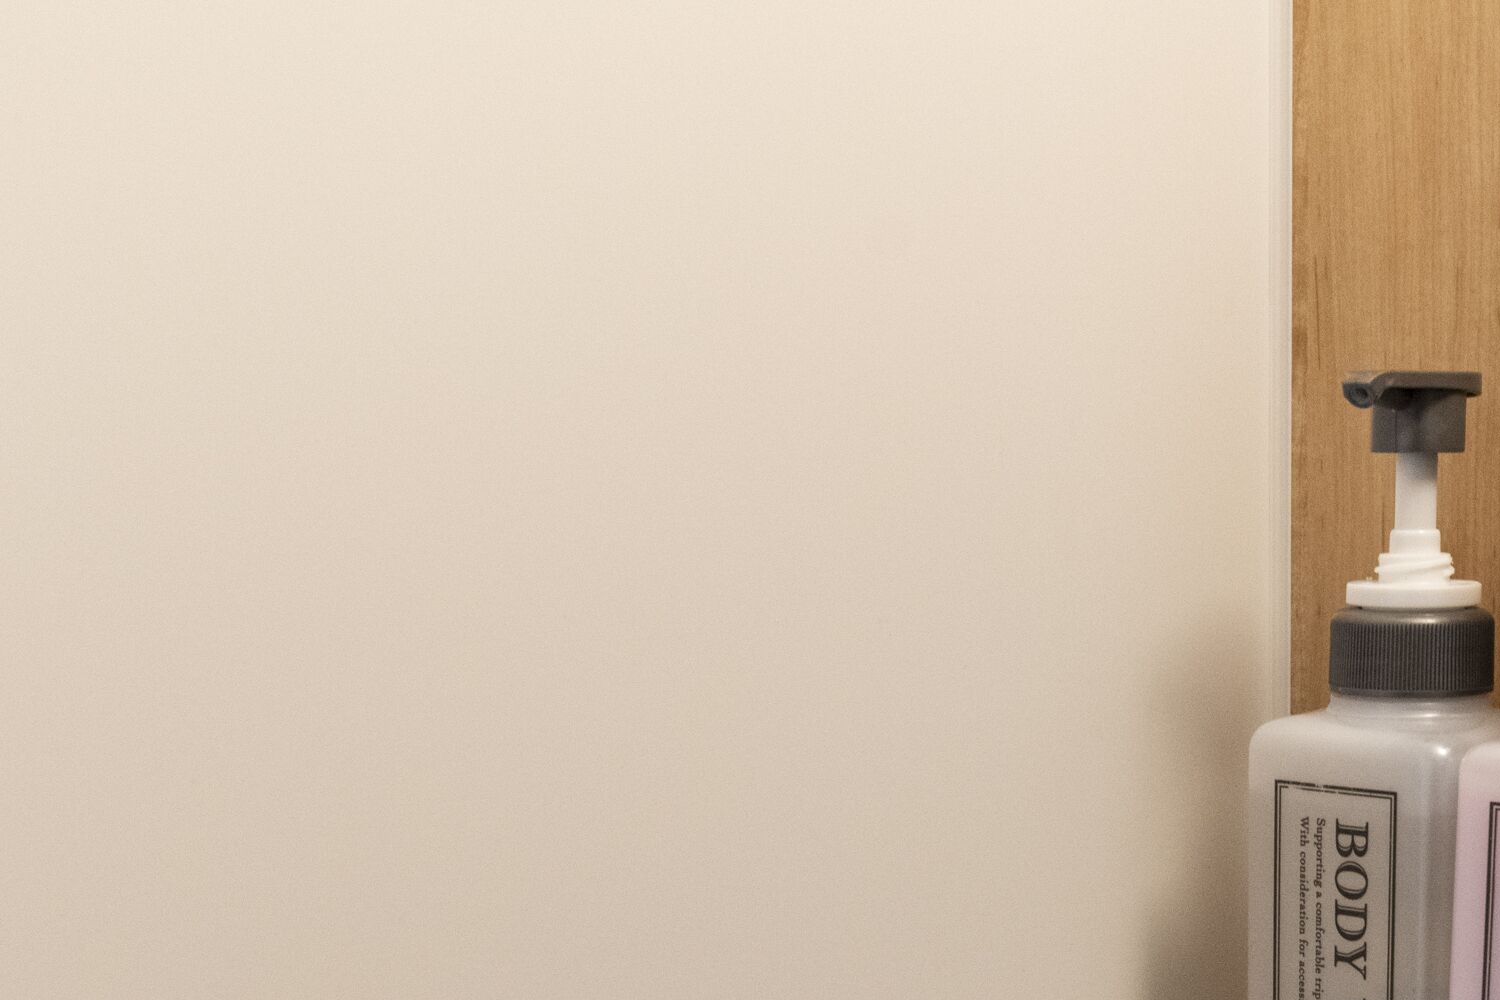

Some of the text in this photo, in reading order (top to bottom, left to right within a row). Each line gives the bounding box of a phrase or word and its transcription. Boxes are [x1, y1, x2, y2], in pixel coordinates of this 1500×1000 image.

[1298, 815, 1310, 847] With
[1311, 816, 1327, 889] Supporting
[1297, 849, 1310, 935] consideration
[1332, 816, 1370, 981] BODY
[1297, 937, 1309, 958] for
[1313, 900, 1326, 975] comfortable
[1310, 976, 1325, 1000] trip
